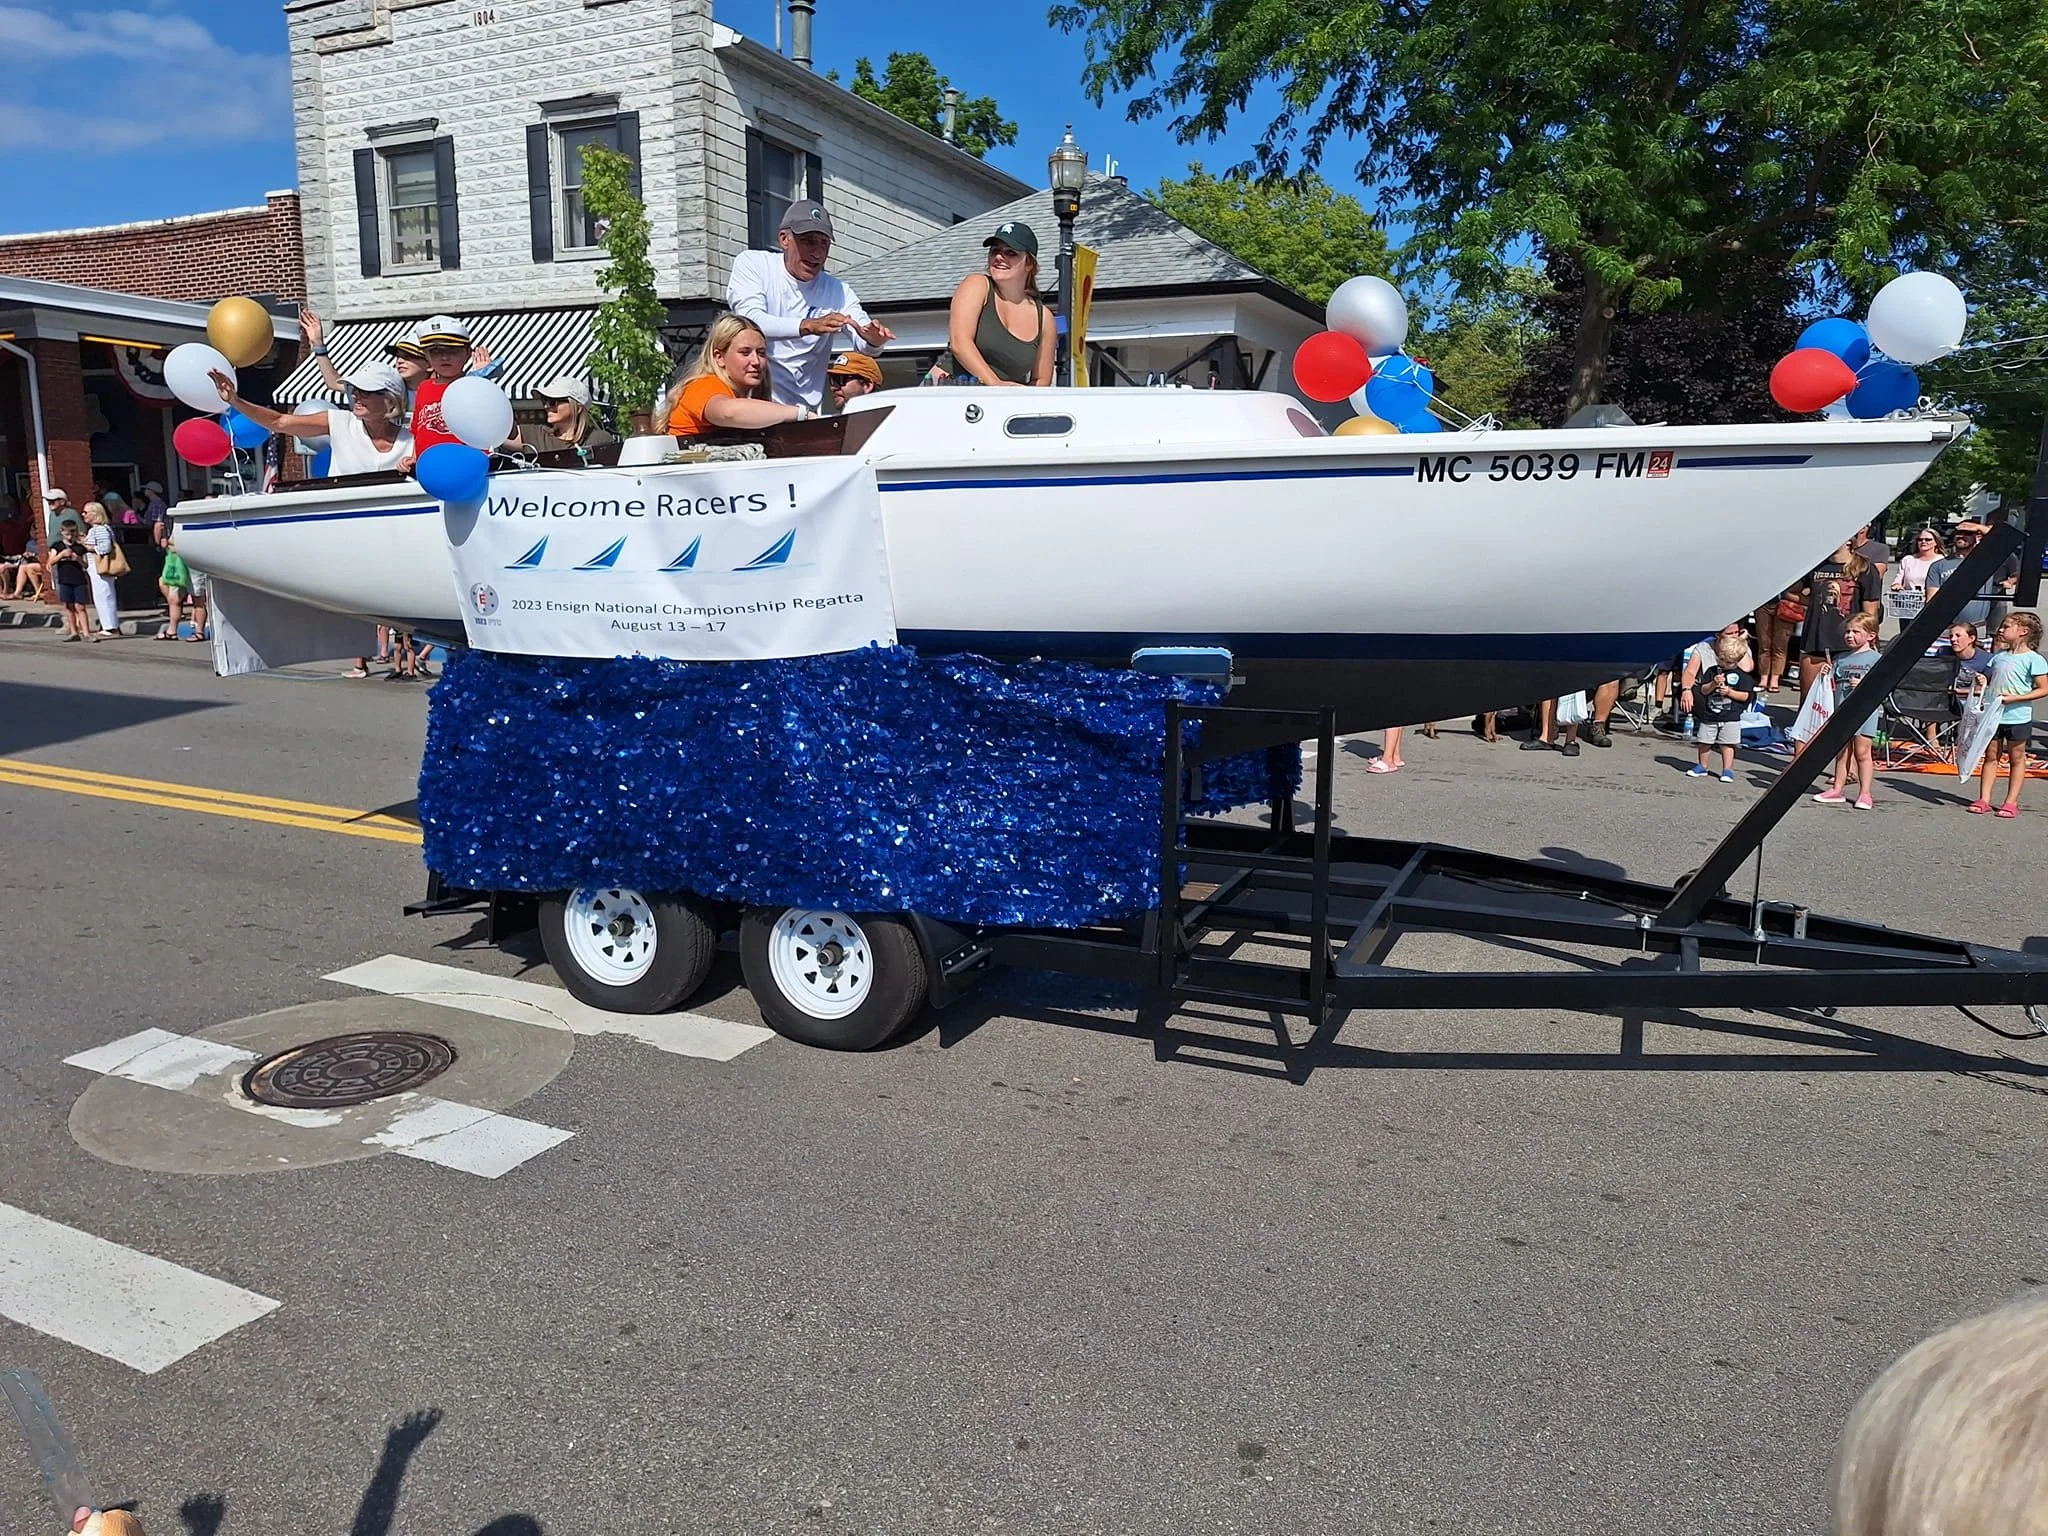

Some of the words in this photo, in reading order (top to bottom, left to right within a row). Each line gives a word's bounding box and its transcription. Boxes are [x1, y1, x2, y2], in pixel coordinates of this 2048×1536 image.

[1418, 456, 1472, 482] MC
[1488, 454, 1580, 481] 5039
[1595, 452, 1645, 478] FM
[1651, 456, 1669, 470] 24
[488, 495, 645, 517] Welcome
[657, 493, 767, 516] Racers
[788, 483, 797, 508] !
[511, 599, 542, 611] 2023
[546, 600, 590, 613] Ensign
[595, 602, 658, 614] National
[662, 600, 787, 618] Championship
[793, 592, 864, 610] Regatta
[611, 619, 663, 633] August
[669, 621, 686, 632] 13
[706, 621, 727, 632] 17
